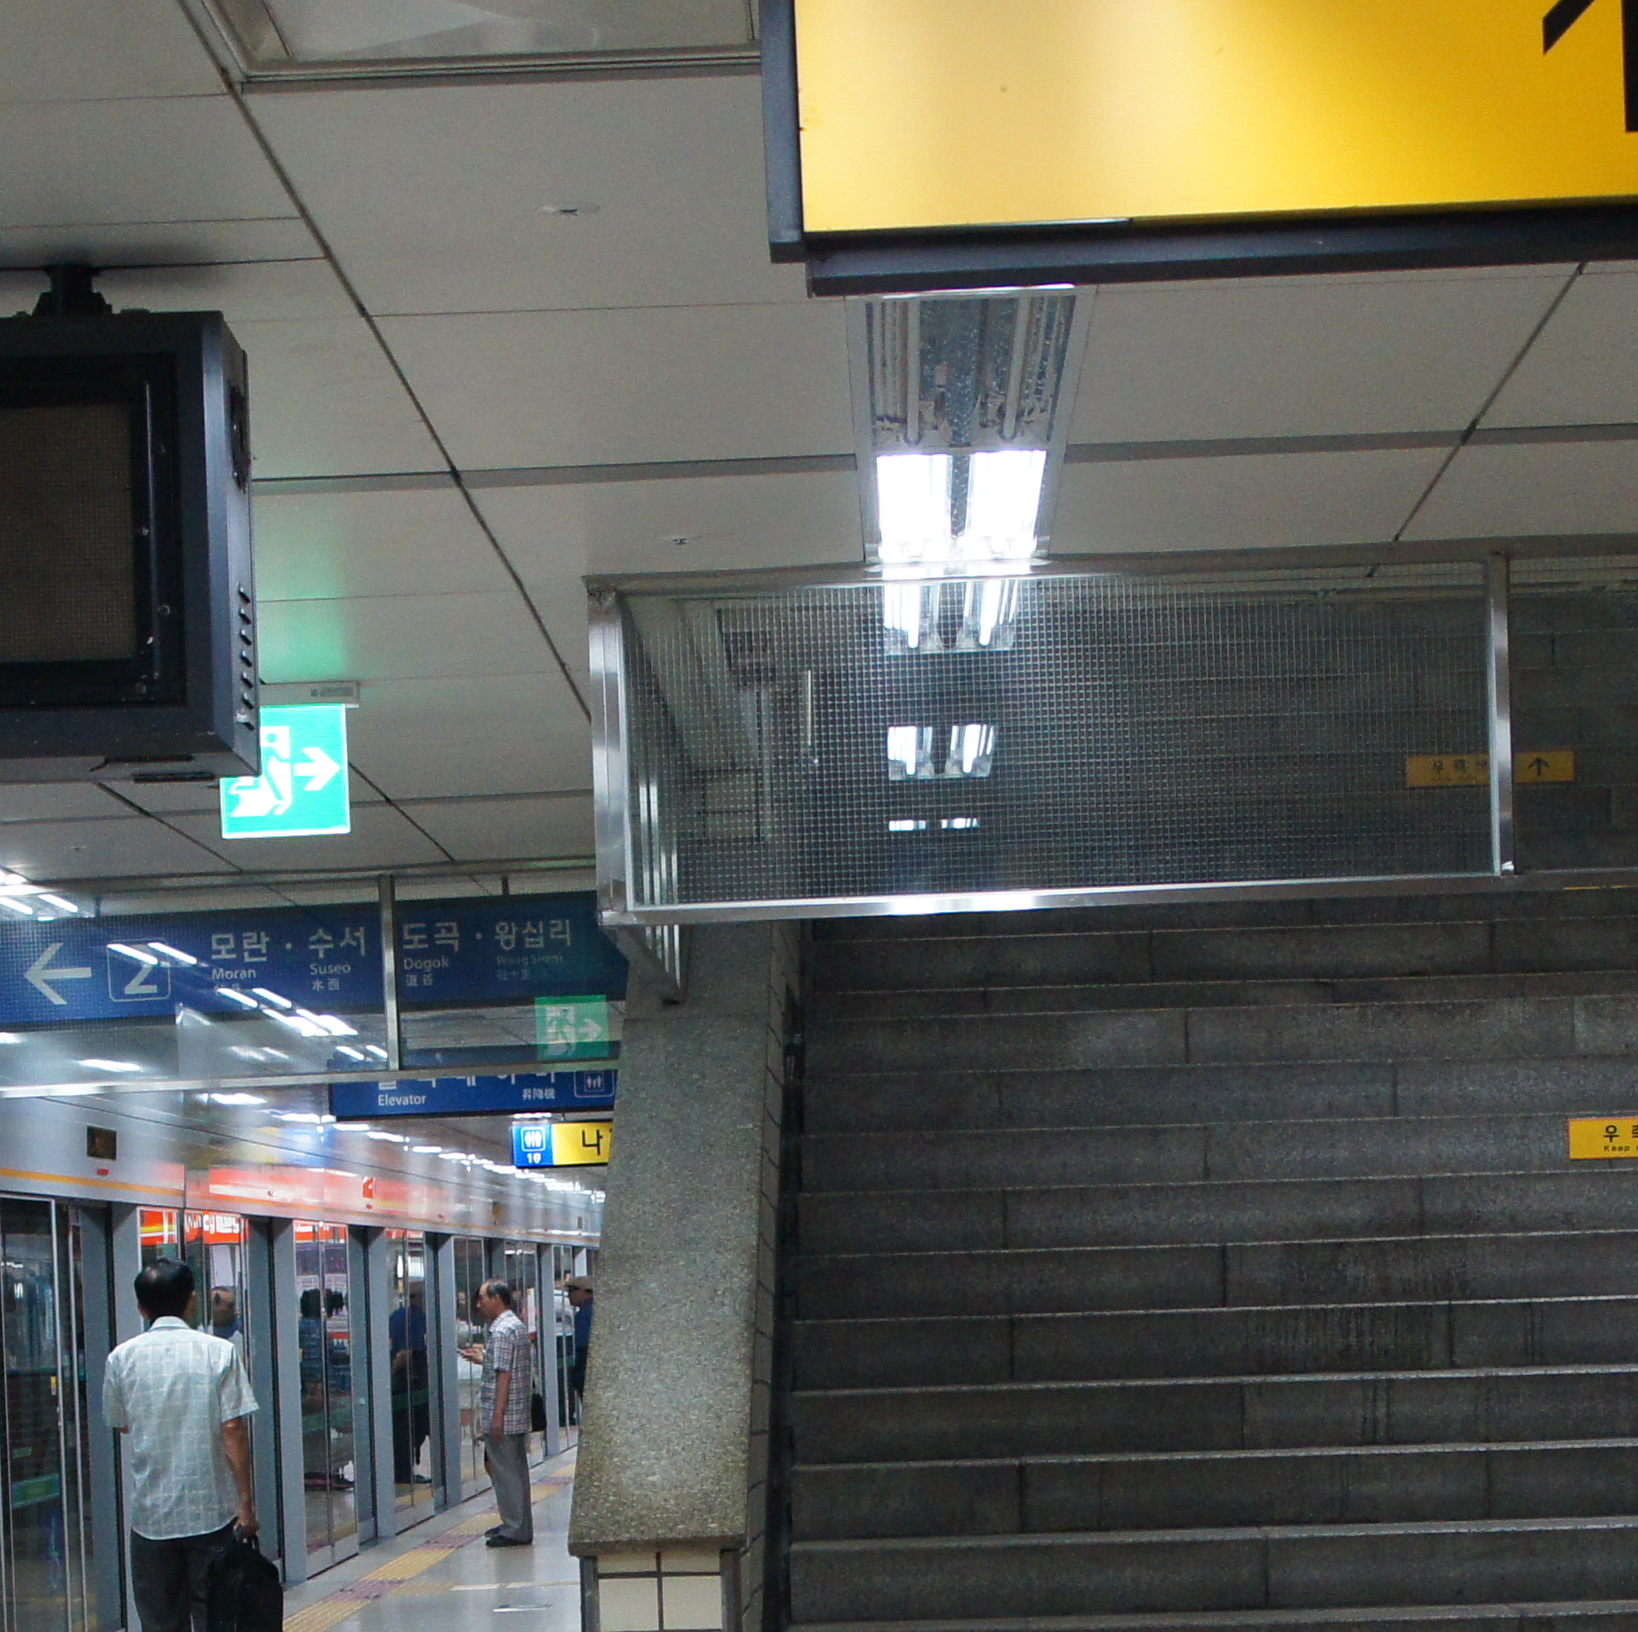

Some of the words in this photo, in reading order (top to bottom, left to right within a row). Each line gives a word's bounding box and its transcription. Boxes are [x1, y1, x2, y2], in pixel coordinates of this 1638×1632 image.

[210, 931, 271, 963] 모란
[308, 925, 367, 959] 수서
[402, 920, 461, 952] 도곡
[494, 918, 572, 951] 왕십리
[212, 967, 257, 981] Moran
[309, 962, 352, 977] Suseo
[403, 955, 451, 973] Dogok
[377, 1092, 428, 1108] Elevator
[1603, 1145, 1631, 1153] Keep
